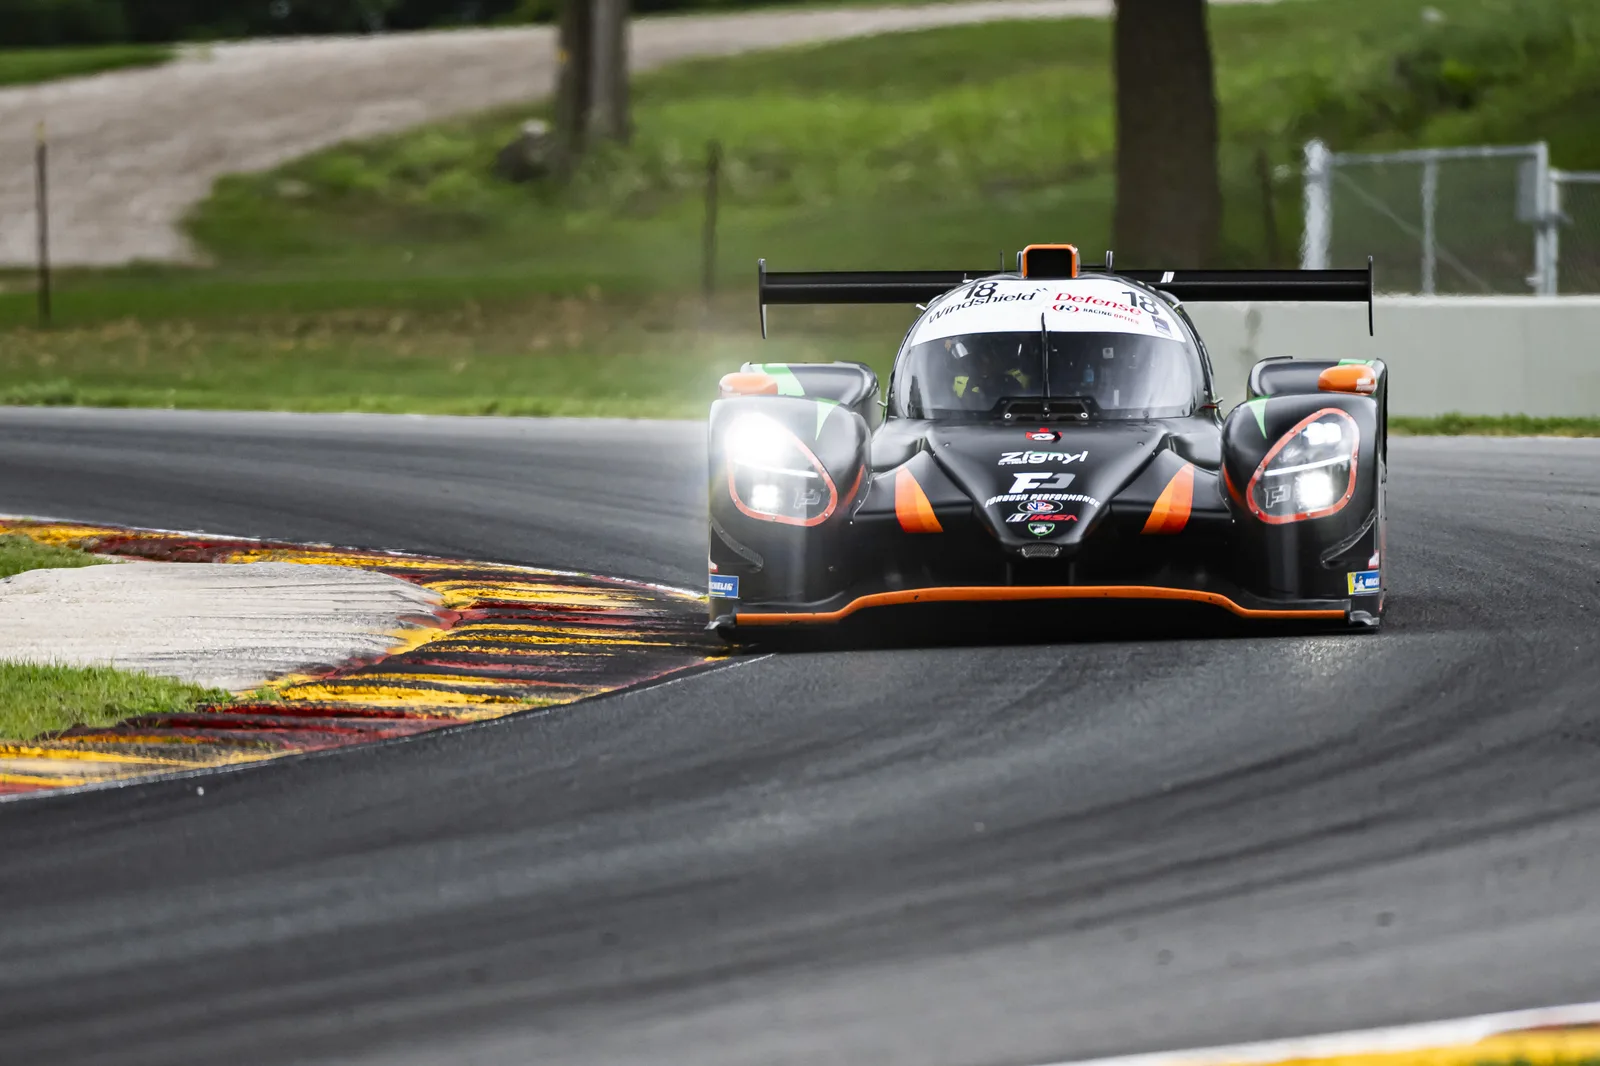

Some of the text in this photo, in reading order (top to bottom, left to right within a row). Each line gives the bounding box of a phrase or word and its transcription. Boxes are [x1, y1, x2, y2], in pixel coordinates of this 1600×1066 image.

[964, 282, 998, 300] 18
[929, 292, 1142, 324] Windshield Defense
[1122, 291, 1159, 315] 18
[1083, 308, 1112, 317] RACING
[1000, 451, 1089, 464] Zignyl
[1030, 493, 1100, 508] PERFORMANCE
[1028, 514, 1079, 522] IMSA
